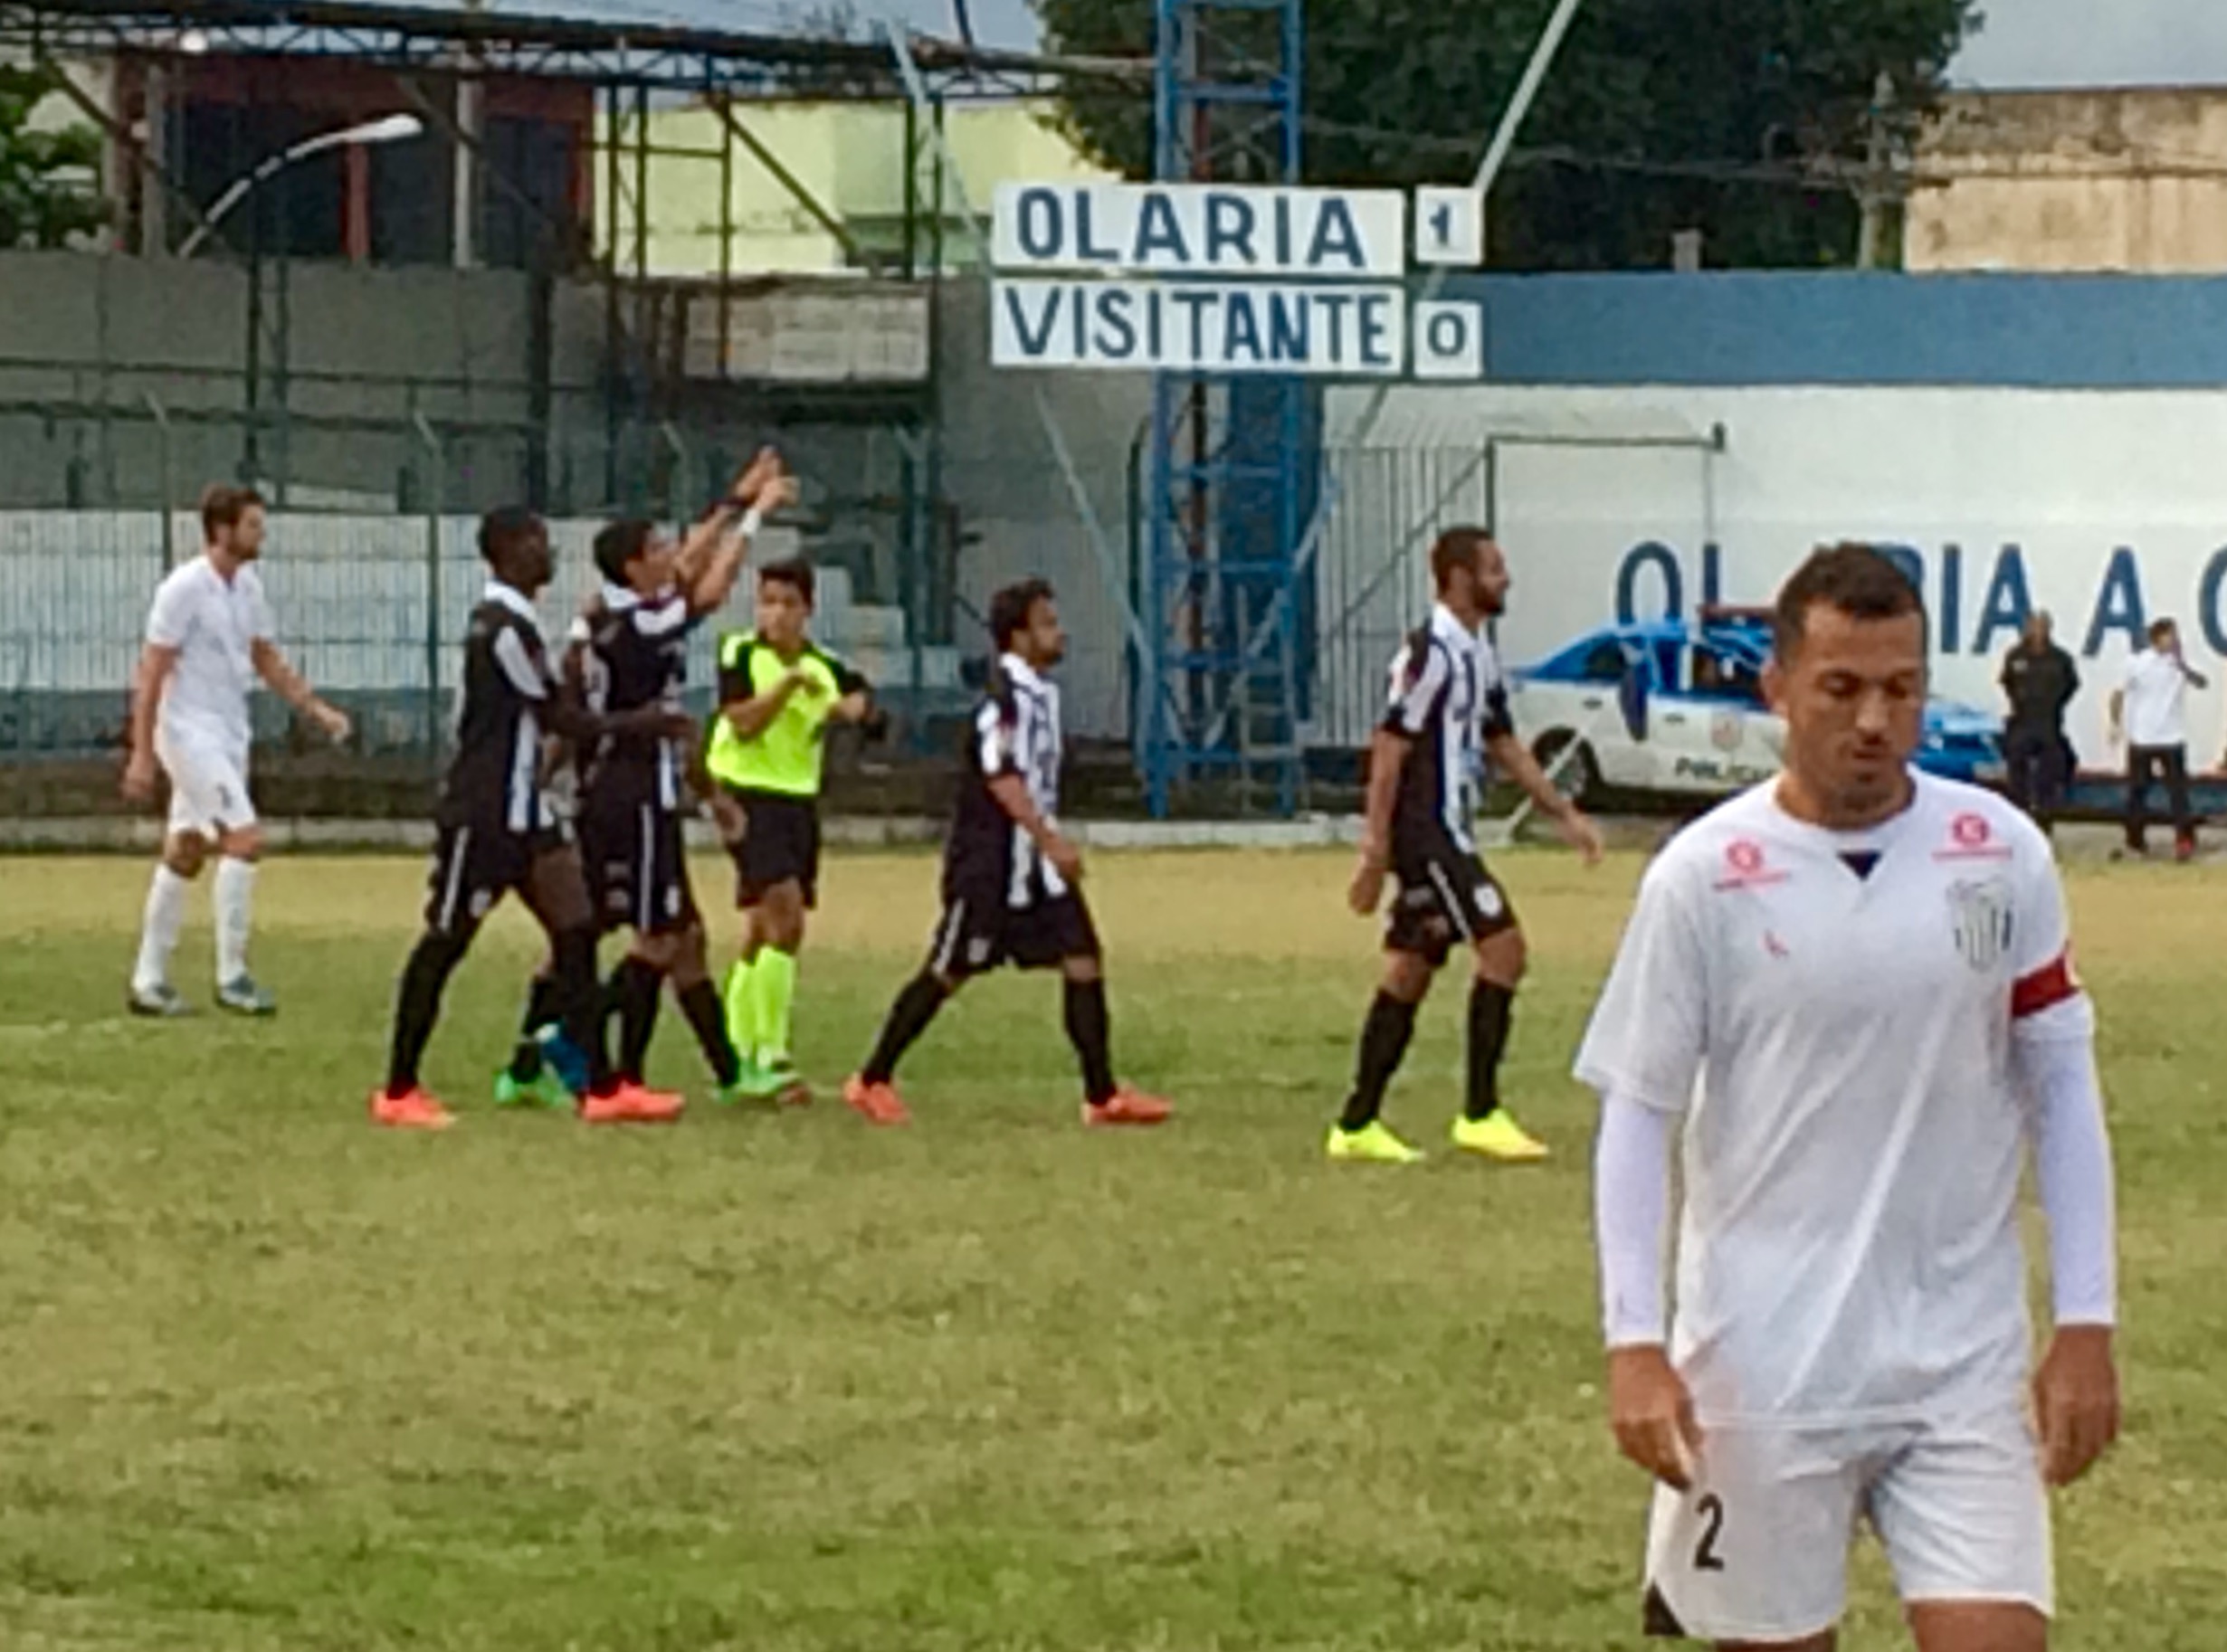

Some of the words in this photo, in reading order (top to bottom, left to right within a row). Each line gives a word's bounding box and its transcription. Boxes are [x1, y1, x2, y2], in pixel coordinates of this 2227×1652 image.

[1016, 186, 1366, 268] OLARIA
[1429, 202, 1451, 245] 1
[1004, 286, 1392, 364] VISITANTE
[1696, 1493, 1724, 1571] 2
